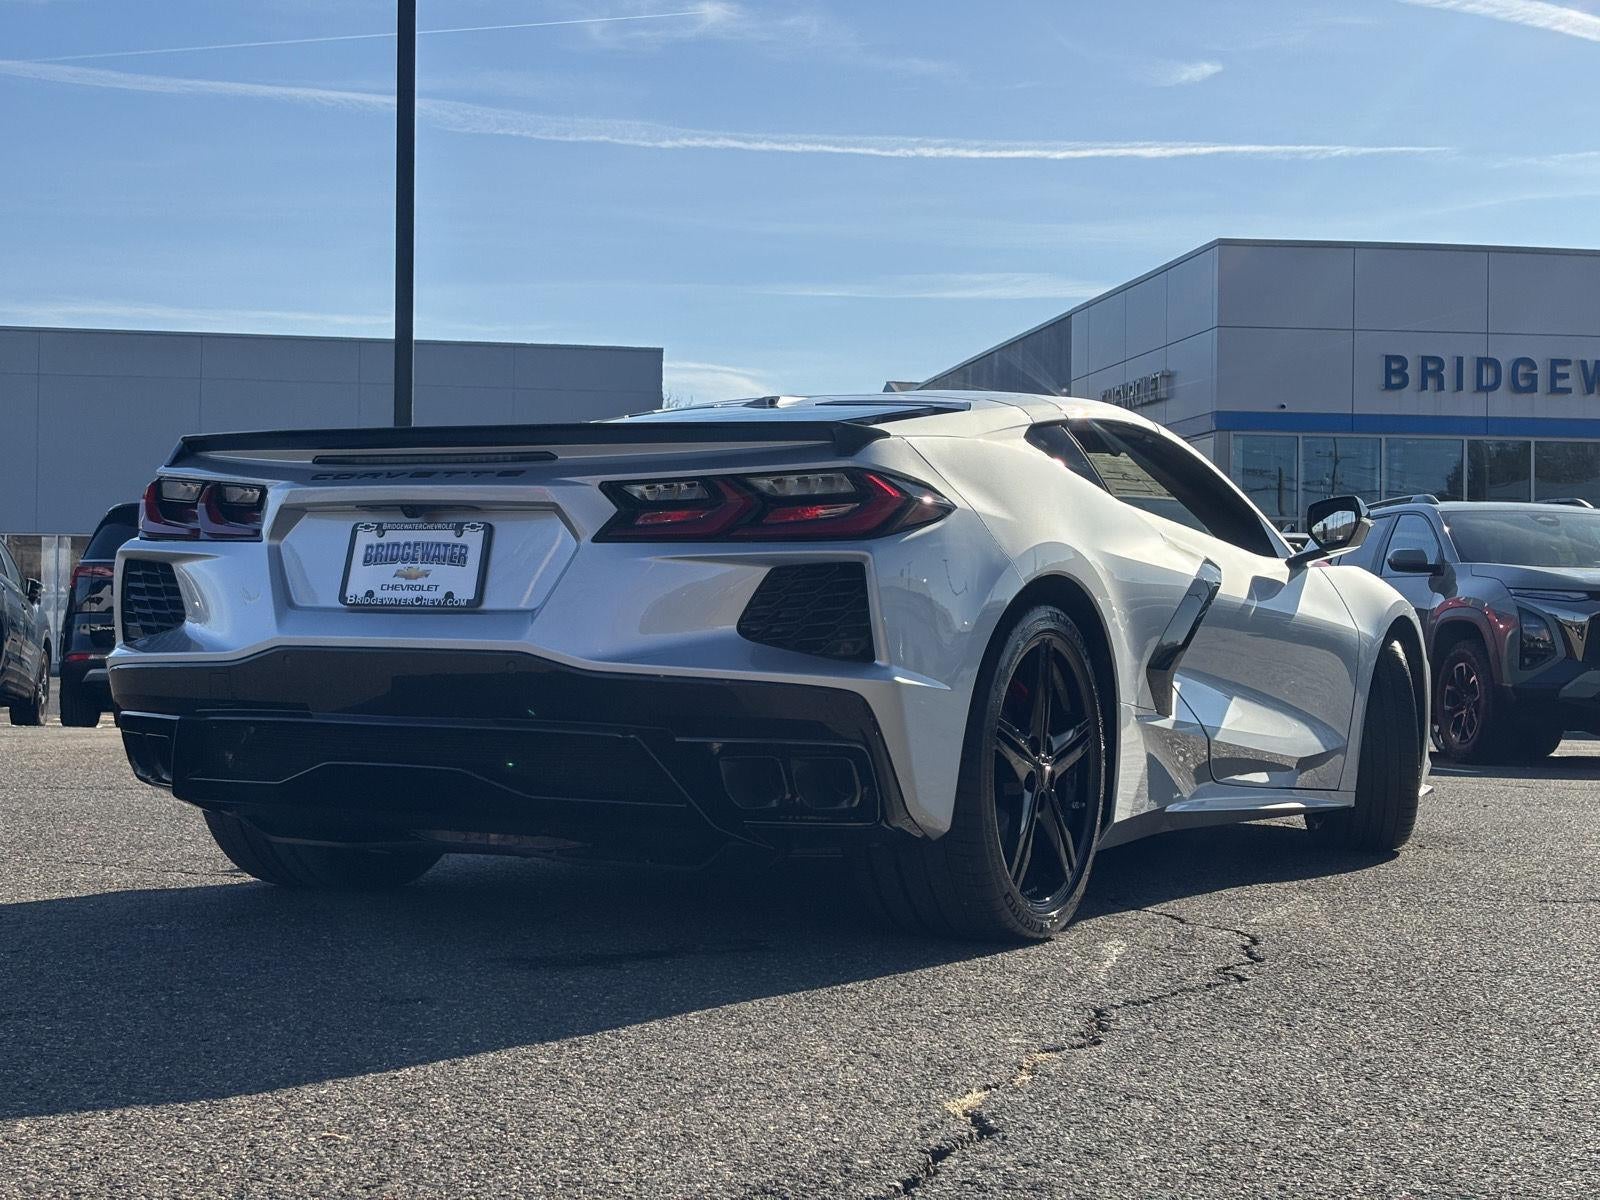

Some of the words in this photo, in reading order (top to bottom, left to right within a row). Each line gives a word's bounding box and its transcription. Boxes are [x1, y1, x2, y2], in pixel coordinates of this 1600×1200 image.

[310, 470, 526, 481] CORVETTE
[362, 541, 470, 567] BRIDGEWATER
[380, 583, 440, 592] CHEVROLET
[346, 594, 467, 608] BRIDGEWATERCHEVY.COM
